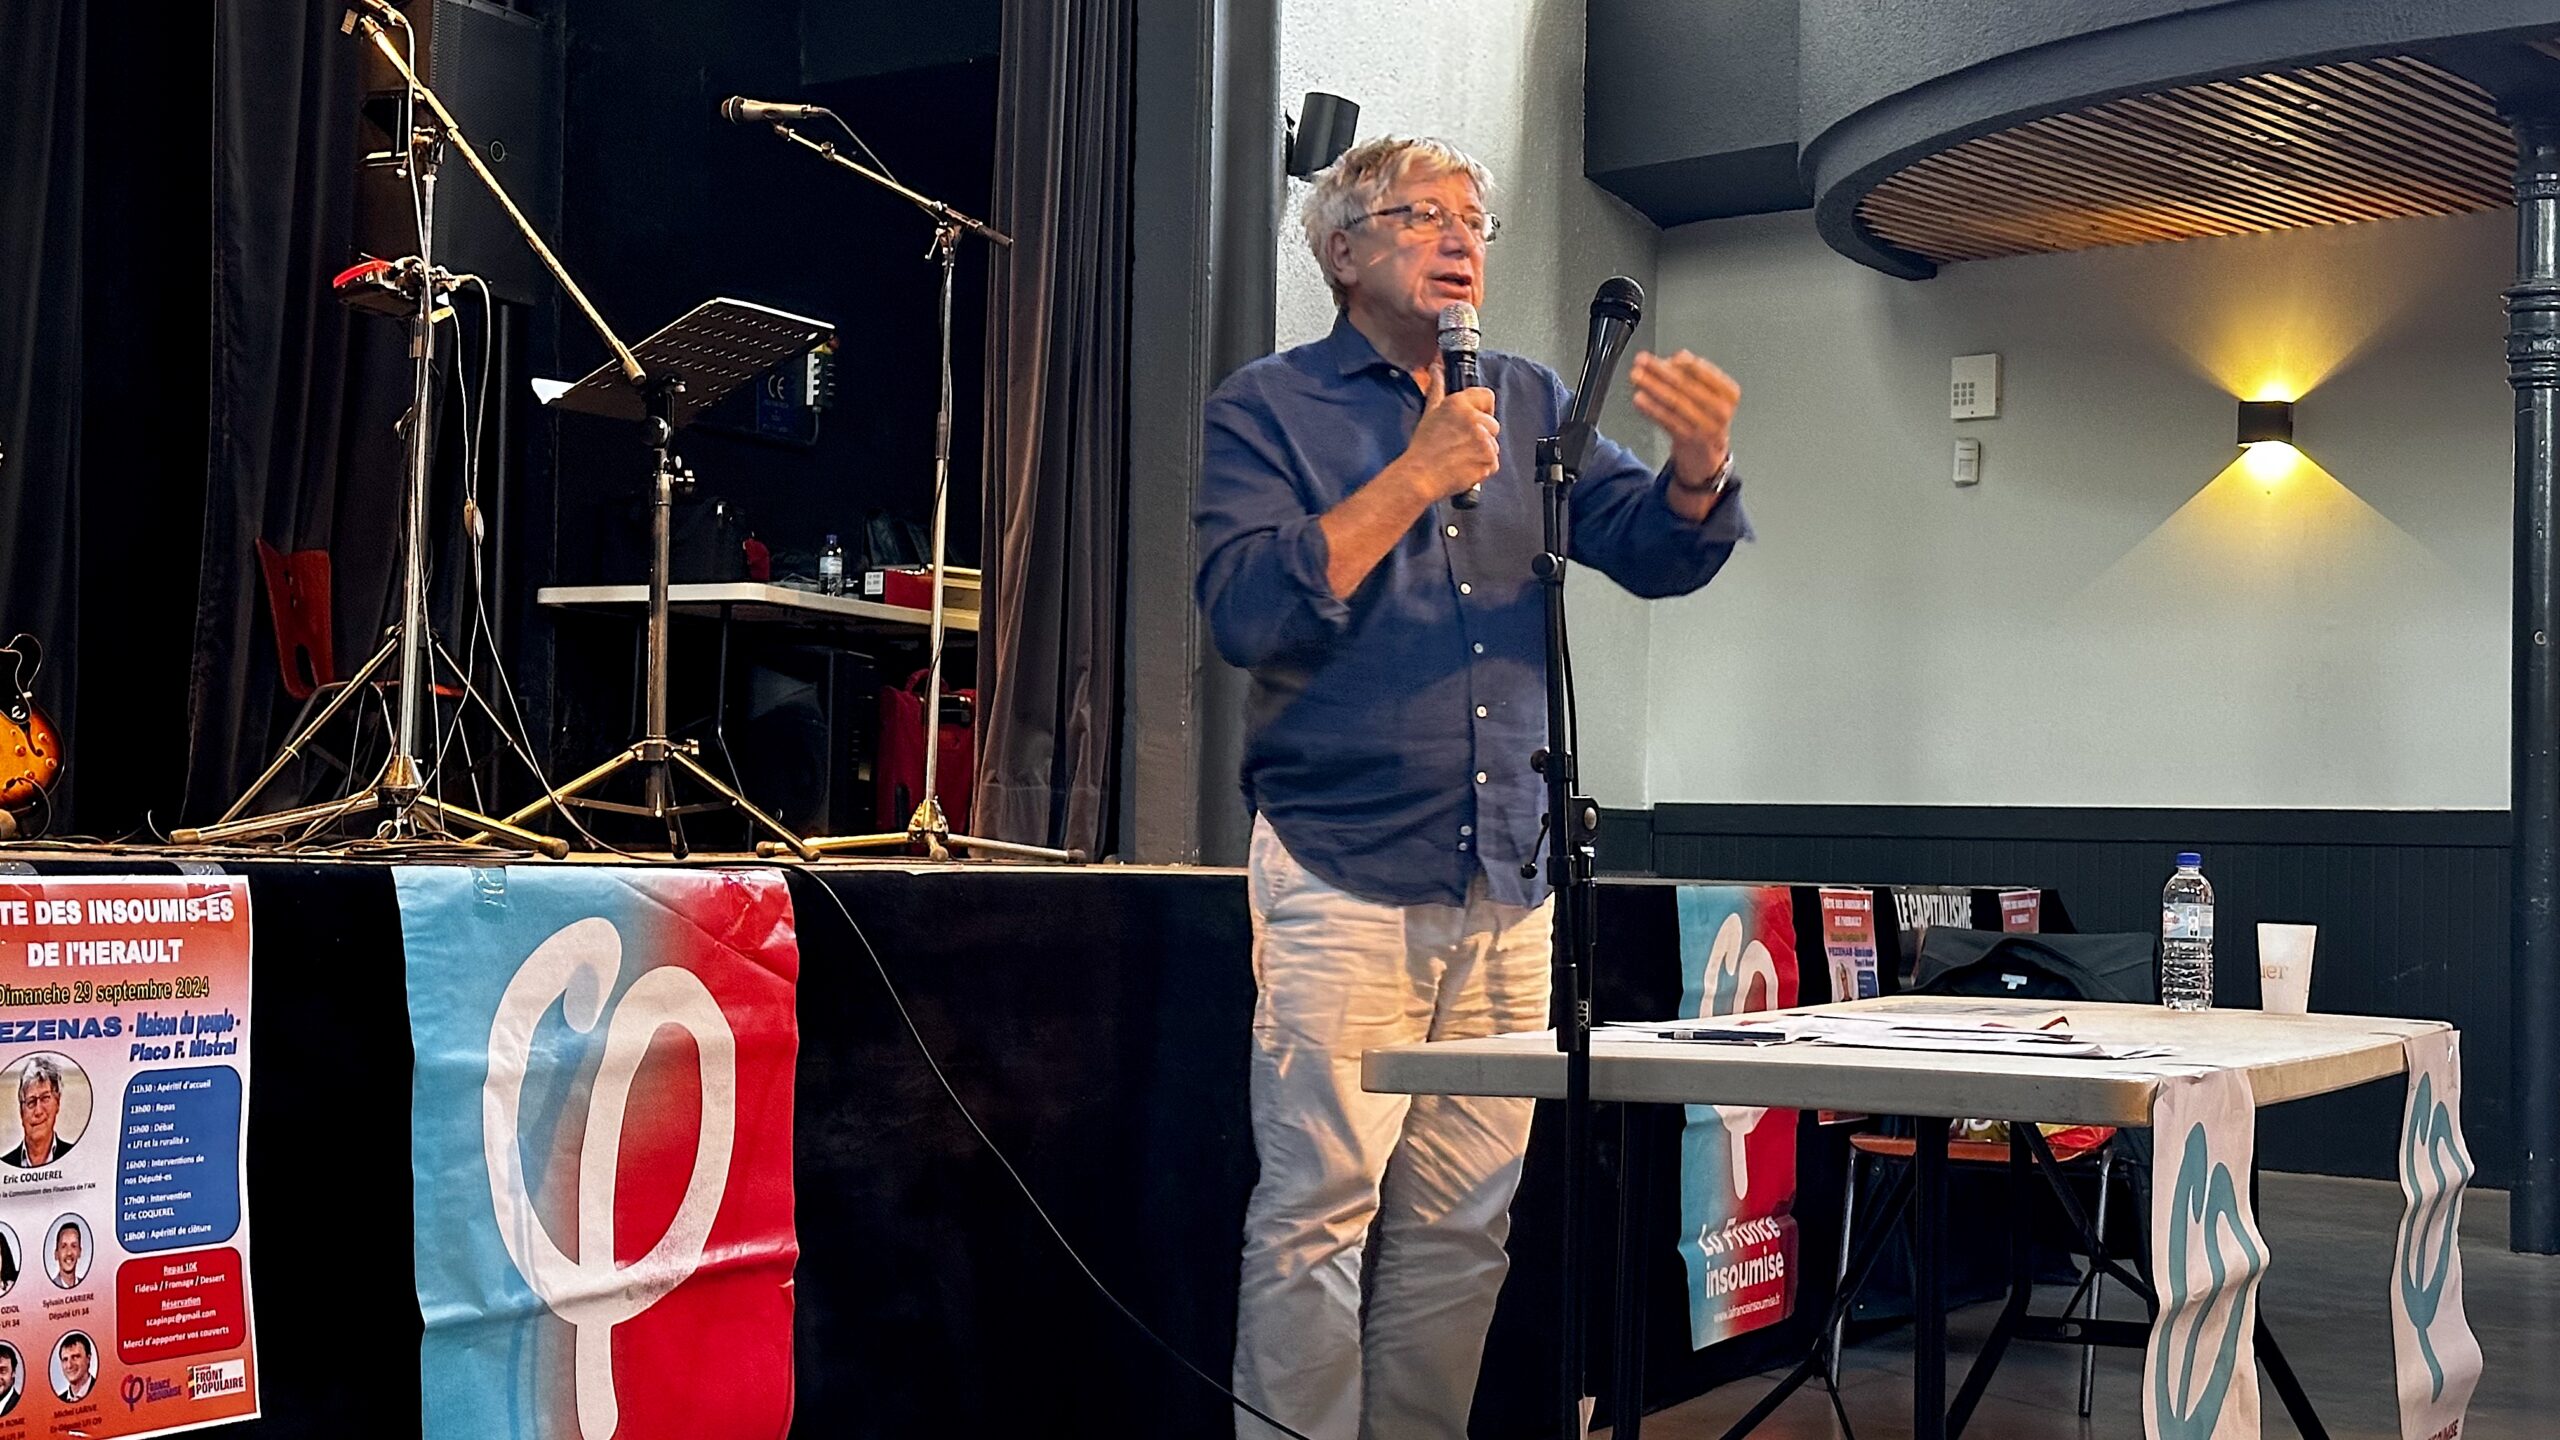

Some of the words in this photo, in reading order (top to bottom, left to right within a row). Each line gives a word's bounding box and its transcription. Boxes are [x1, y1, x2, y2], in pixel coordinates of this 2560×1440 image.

[768, 375, 784, 399] CE
[34, 900, 82, 925] DES
[1894, 894, 1910, 931] LE
[1908, 894, 1972, 930] CAPITALISME
[27, 942, 60, 967] DE
[0, 982, 70, 1006] Dimanche
[74, 980, 93, 1003] 29
[96, 979, 172, 1007] septembre
[175, 976, 209, 998] 2024
[0, 1016, 122, 1043] EZENAS
[135, 1011, 178, 1037] Maison
[180, 1010, 195, 1035] du
[195, 1008, 235, 1040] peuple
[174, 1041, 185, 1058] F.
[189, 1037, 238, 1058] Mistral
[132, 1084, 153, 1094] 11h30
[157, 1081, 181, 1092] Apéritif
[182, 1079, 211, 1090] d'accueil
[156, 1103, 176, 1114] Repas
[154, 1123, 174, 1132] Débat
[133, 1140, 143, 1149] LFI
[152, 1138, 159, 1147] la
[159, 1136, 183, 1146] ruralité
[151, 1156, 195, 1167] Interventions
[196, 1153, 205, 1163] de
[3, 1175, 19, 1185] Eric
[20, 1170, 63, 1183] COQUEREL
[124, 1177, 137, 1185] nos
[138, 1173, 173, 1185] Député-es
[124, 1195, 146, 1205] 17h00
[150, 1191, 192, 1203] Intervention
[124, 1211, 137, 1221] Eric
[138, 1207, 175, 1220] COQUEREL
[150, 1226, 177, 1239] Apéritif
[178, 1226, 186, 1235] de
[1698, 1223, 1725, 1257] La
[1722, 1216, 1781, 1251] France
[163, 1264, 184, 1276] Repas
[1706, 1245, 1784, 1299] insoumise
[164, 1276, 194, 1289] Fromage
[200, 1273, 225, 1285] Dessert
[161, 1296, 202, 1311] Réservation
[123, 1339, 144, 1350] Merci
[187, 1330, 199, 1339] vos
[200, 1326, 230, 1338] couverts
[196, 1368, 223, 1383] FRONT
[196, 1376, 244, 1395] POPULAIRE
